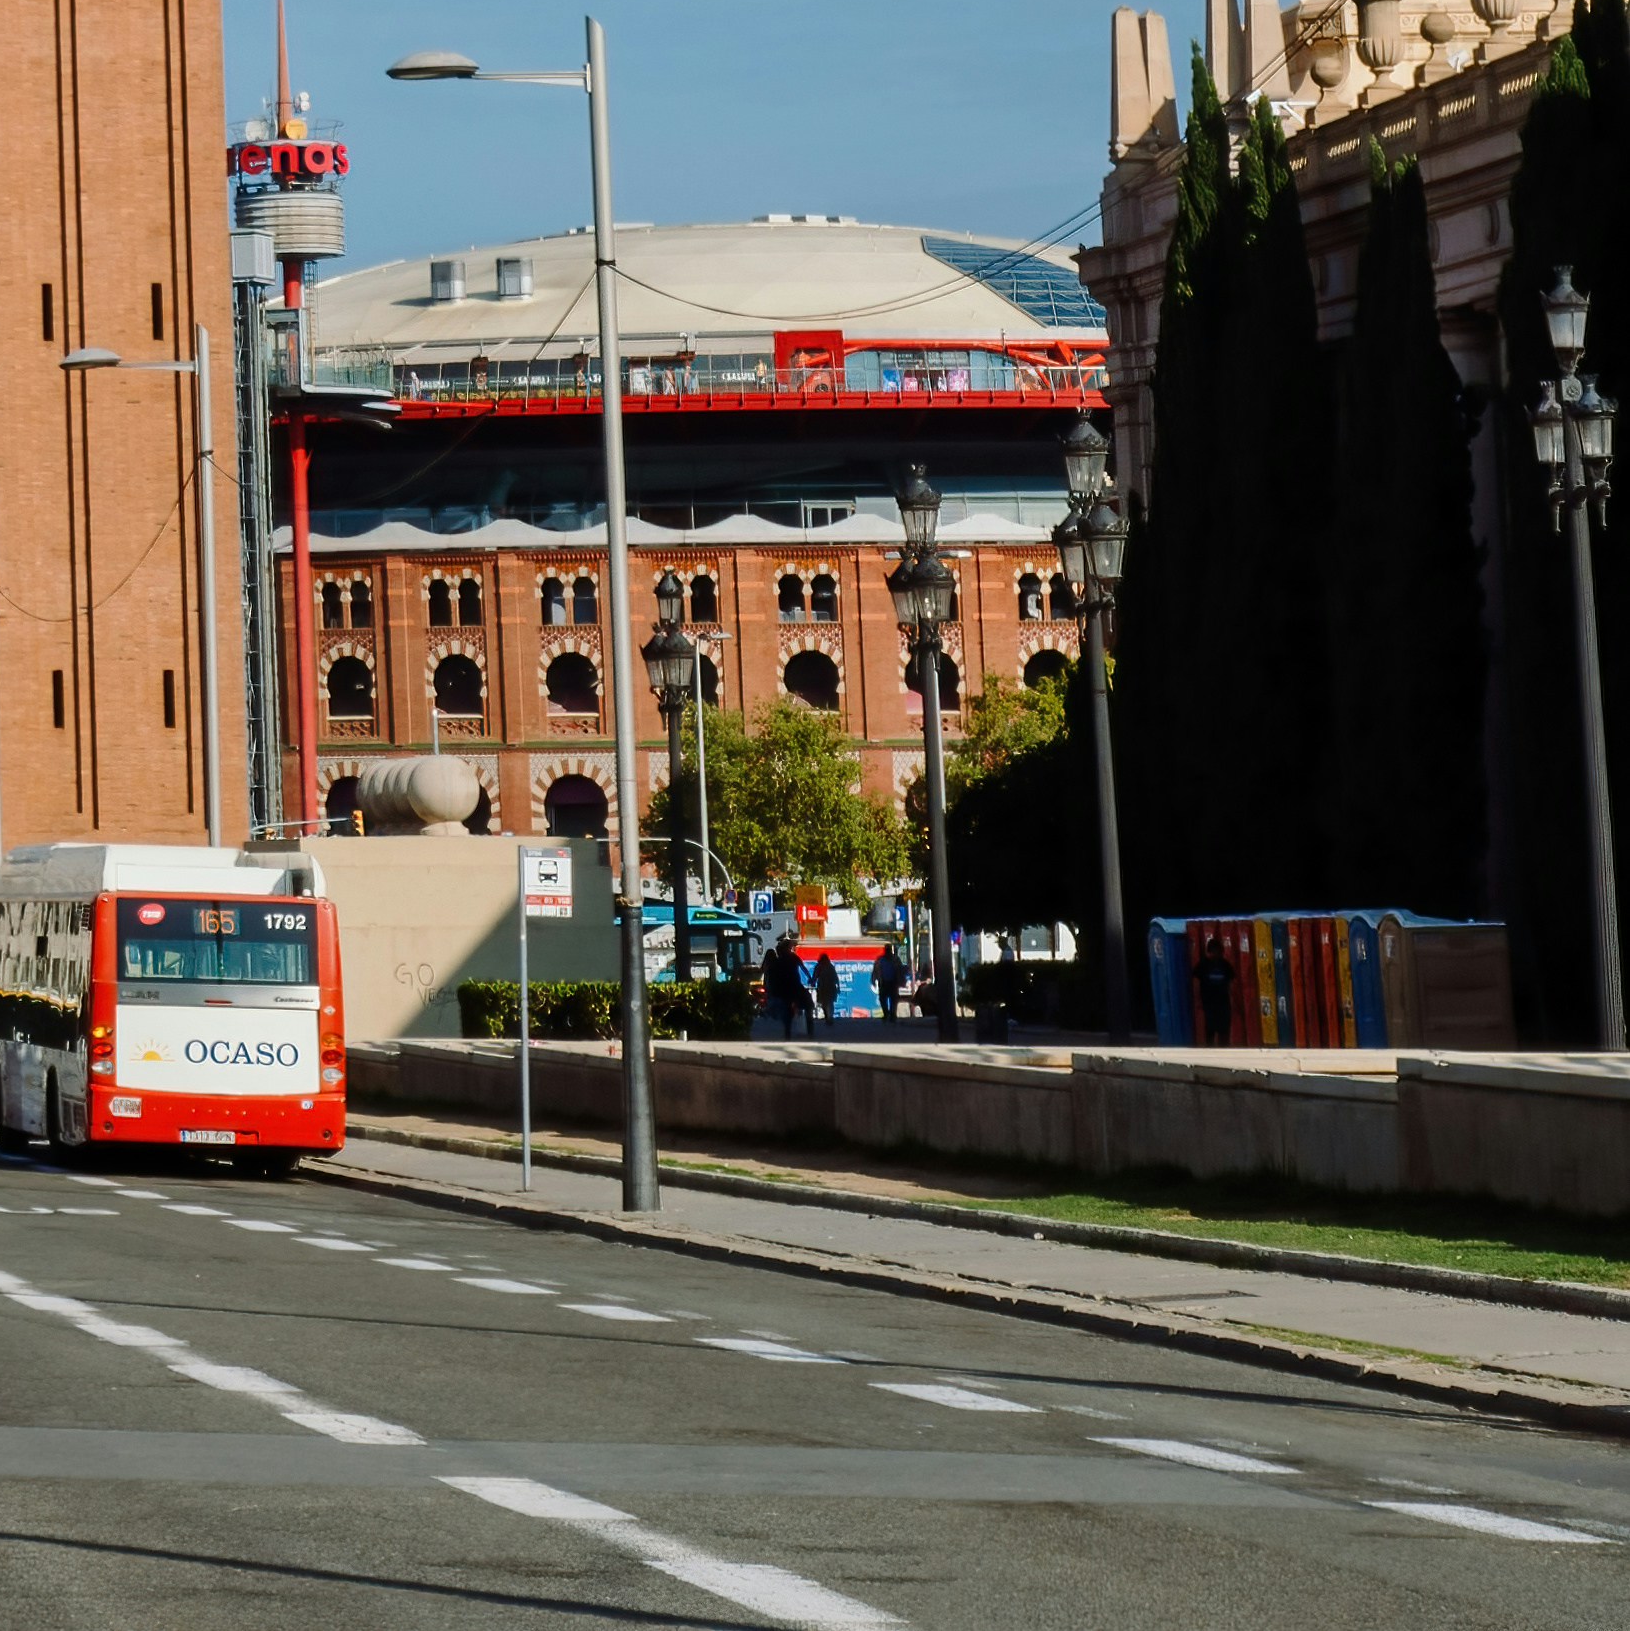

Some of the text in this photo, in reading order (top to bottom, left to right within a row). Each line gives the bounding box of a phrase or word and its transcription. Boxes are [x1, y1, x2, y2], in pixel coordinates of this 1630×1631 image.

[198, 910, 235, 935] 165
[264, 914, 307, 930] 1792
[394, 963, 435, 987] GO
[185, 1040, 299, 1067] OCASO
